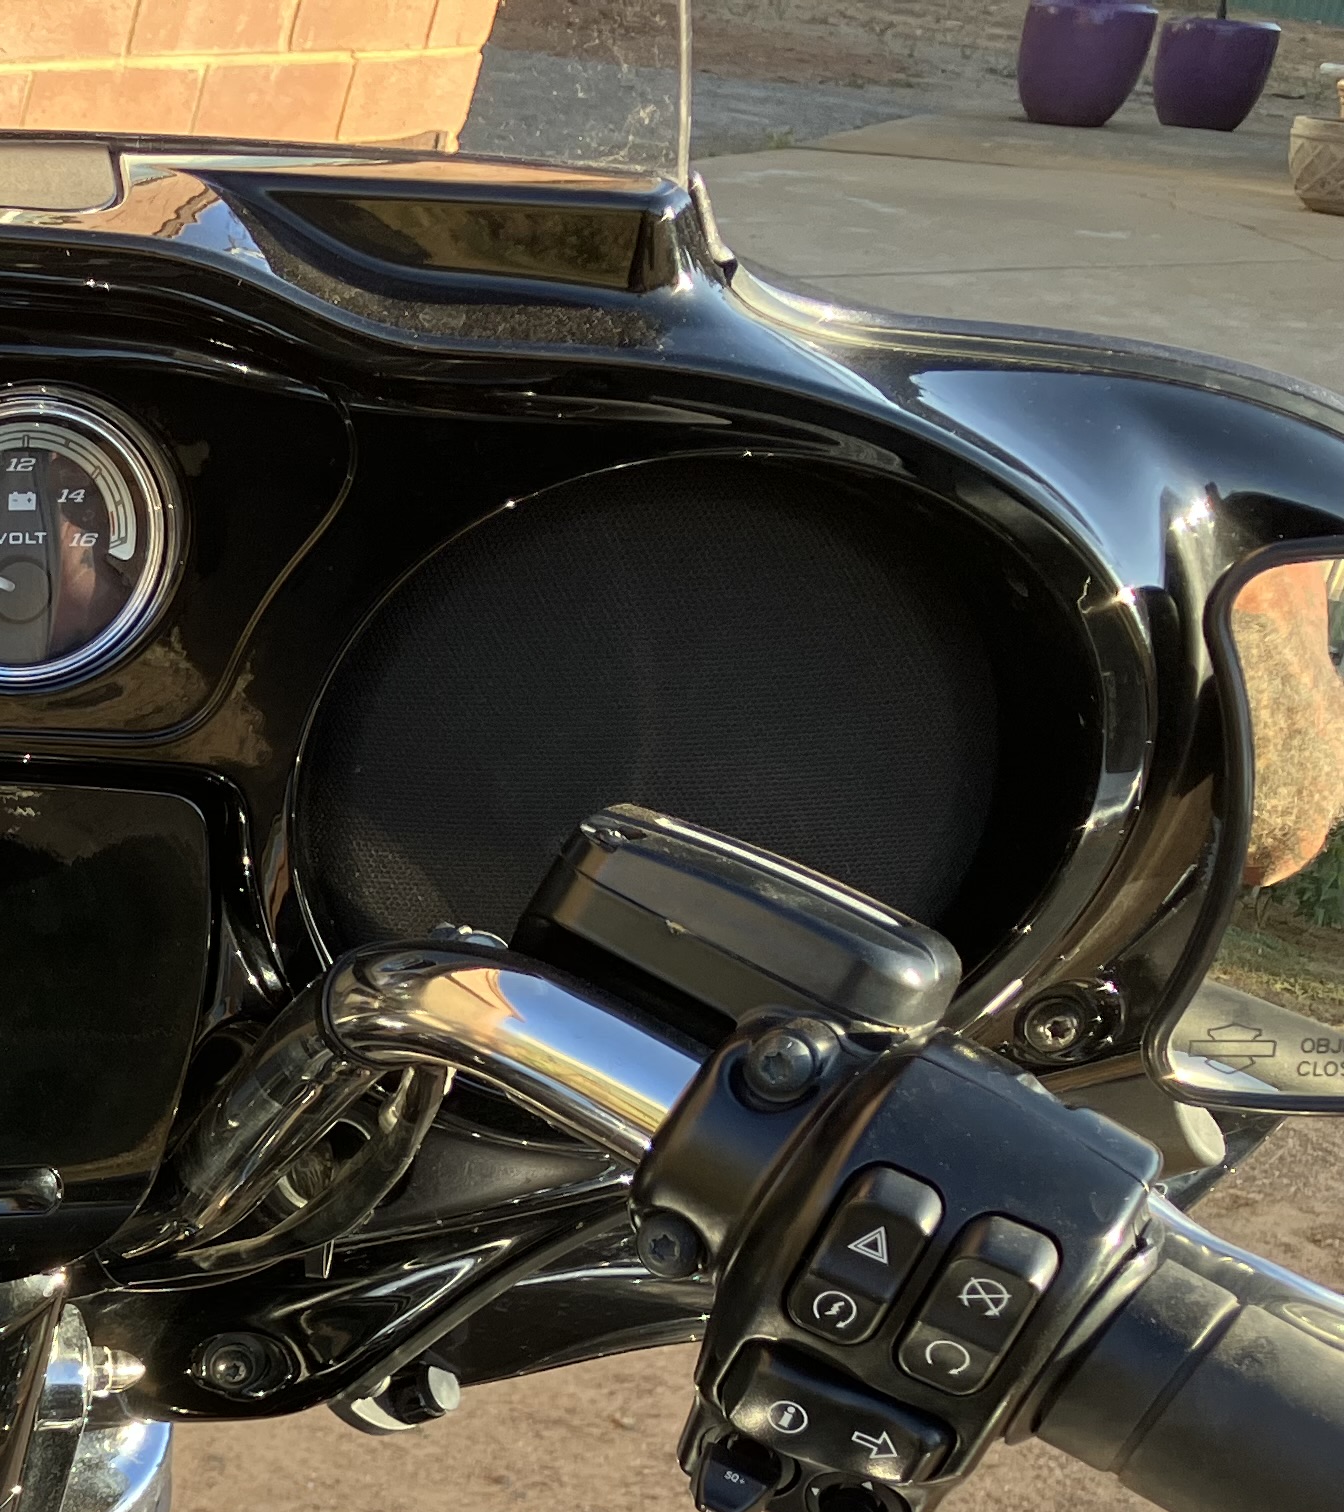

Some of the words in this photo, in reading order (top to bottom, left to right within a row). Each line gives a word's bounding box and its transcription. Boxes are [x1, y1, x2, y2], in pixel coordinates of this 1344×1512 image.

[6, 457, 36, 472] 12
[57, 488, 85, 503] 14
[69, 533, 98, 547] 16
[1300, 1037, 1344, 1054] OBJ
